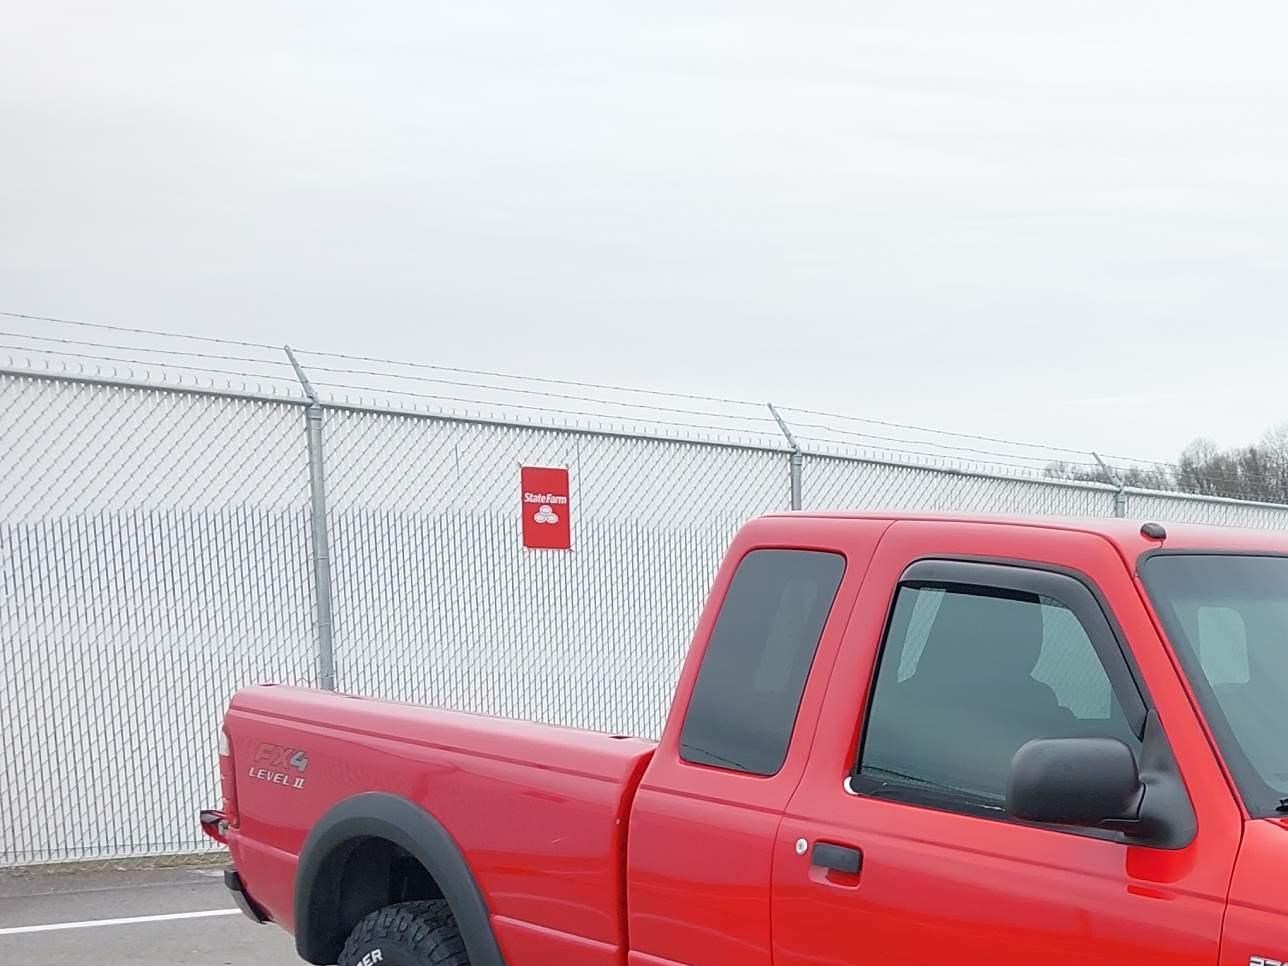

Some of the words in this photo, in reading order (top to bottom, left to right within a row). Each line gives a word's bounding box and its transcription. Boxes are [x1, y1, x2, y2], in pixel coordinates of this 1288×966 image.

[255, 743, 309, 771] FX4
[249, 767, 290, 786] LEVEL
[291, 777, 305, 789] II
